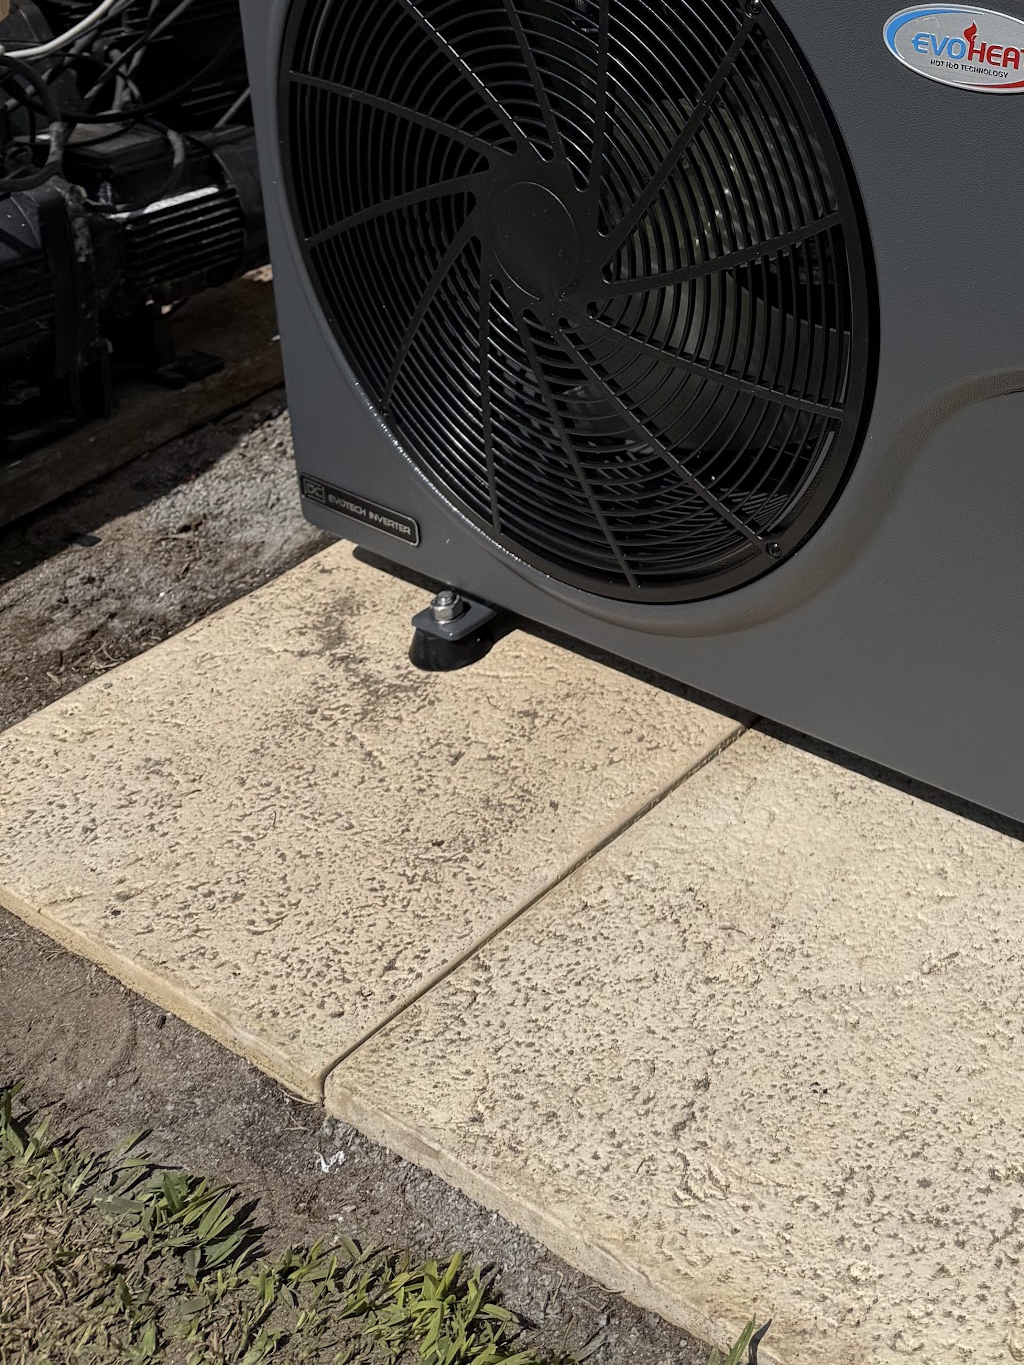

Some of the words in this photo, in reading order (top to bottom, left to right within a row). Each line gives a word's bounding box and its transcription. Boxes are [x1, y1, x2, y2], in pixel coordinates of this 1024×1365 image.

[930, 59, 945, 67] HOT
[961, 64, 1009, 78] TECHNOLOGY
[327, 494, 366, 516] EVOTECH
[368, 511, 412, 535] INVERTER
